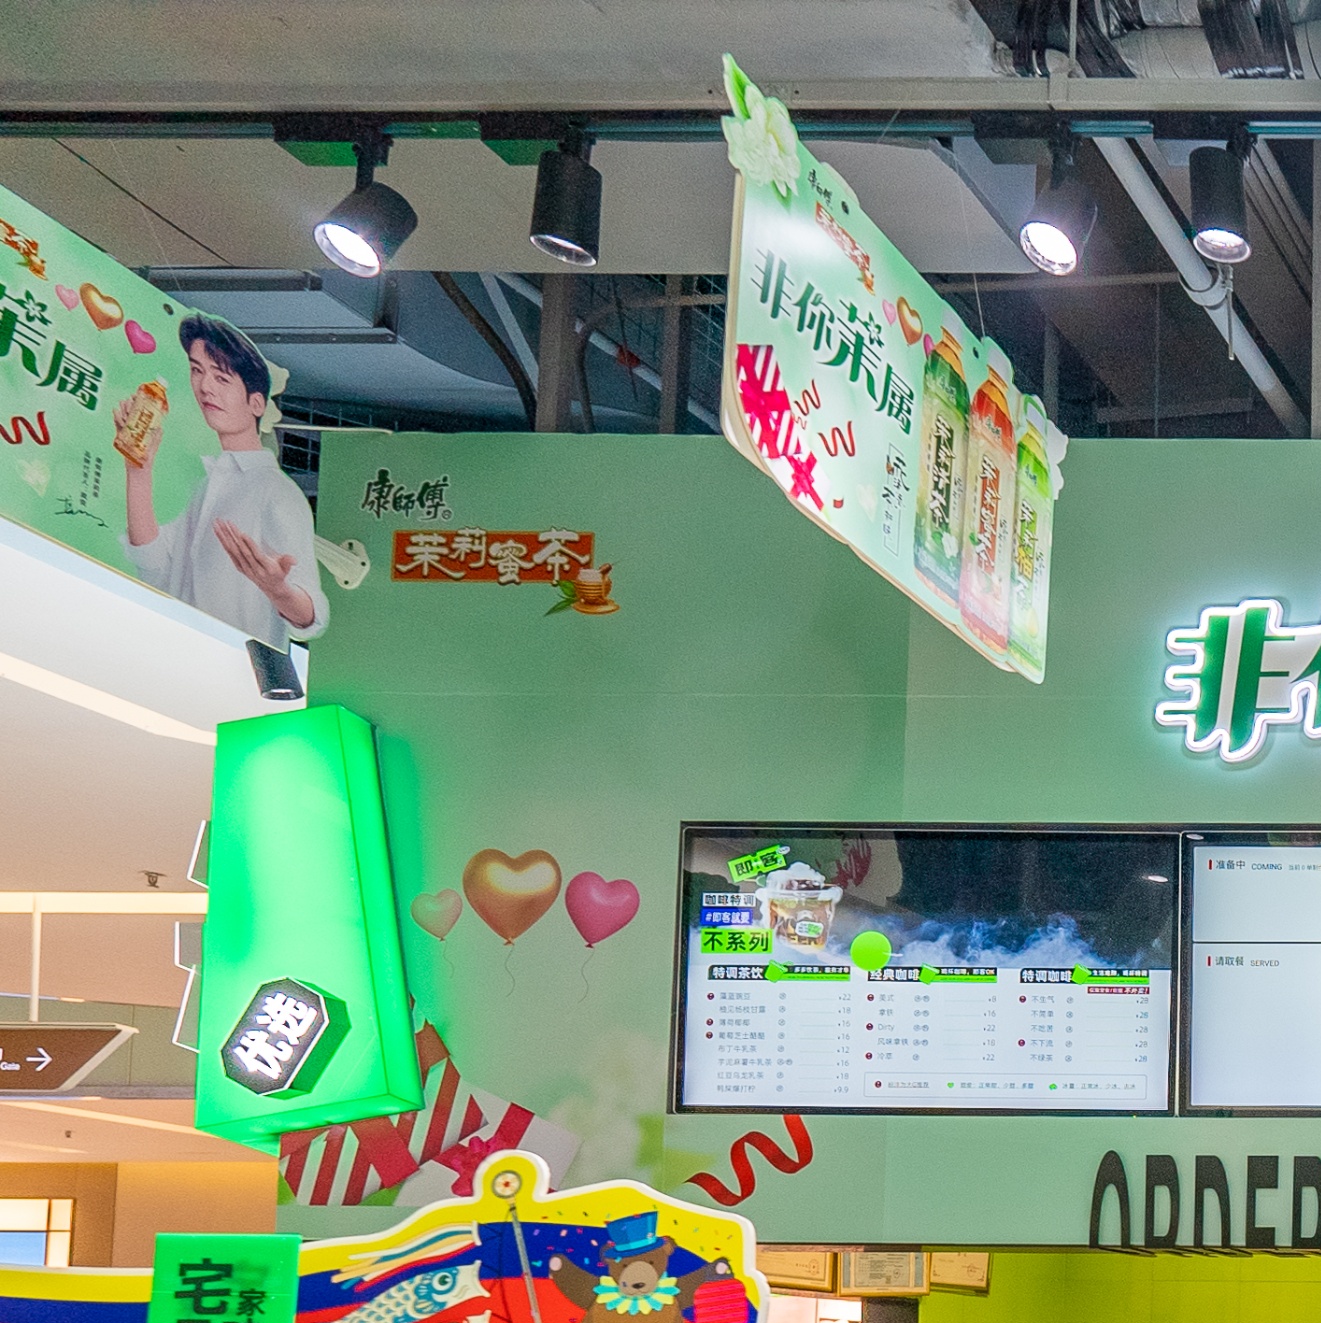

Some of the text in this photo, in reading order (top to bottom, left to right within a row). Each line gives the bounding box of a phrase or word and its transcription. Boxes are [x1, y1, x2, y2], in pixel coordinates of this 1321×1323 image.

[750, 248, 916, 437] 非你茉属
[394, 526, 590, 587] 茉莉蜜茶
[1215, 859, 1283, 871] 准备中 COMING
[703, 931, 770, 952] 不系列
[1215, 955, 1245, 967] 请取餐
[233, 990, 319, 1082] 优选
[174, 1257, 267, 1316] 宅家
